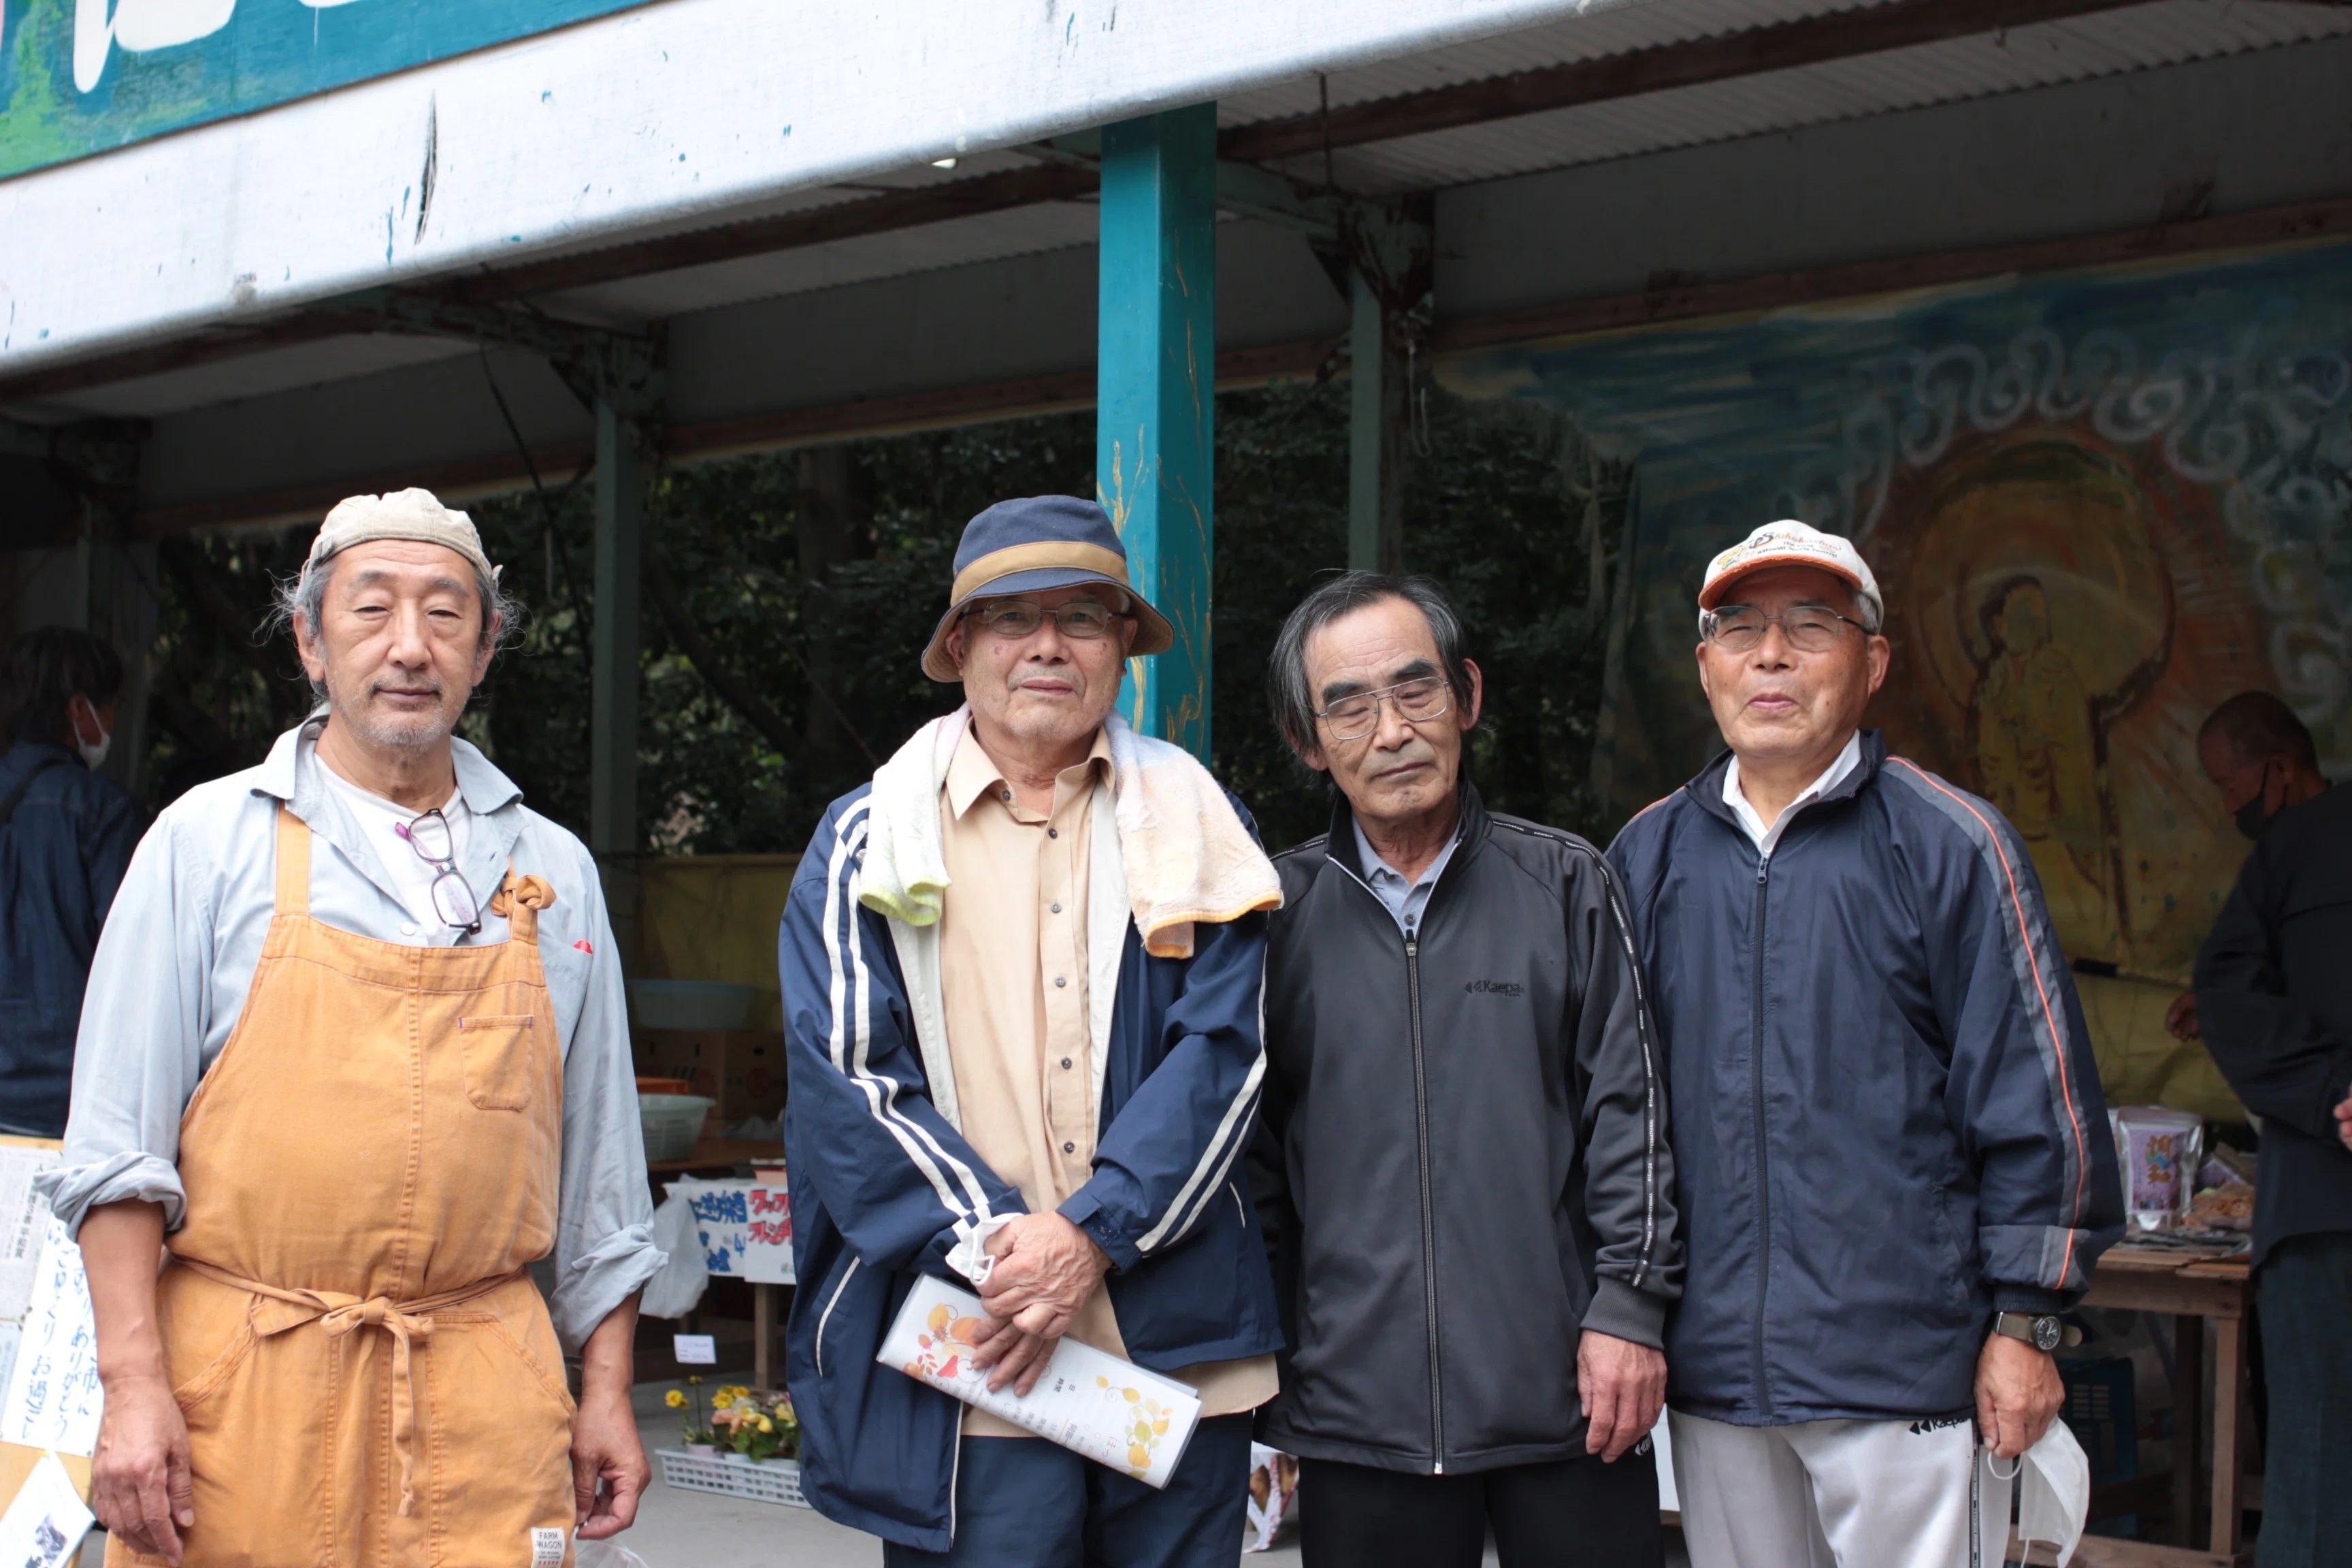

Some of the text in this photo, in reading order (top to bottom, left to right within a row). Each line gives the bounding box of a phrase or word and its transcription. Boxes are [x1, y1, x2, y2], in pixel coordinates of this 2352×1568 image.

[1483, 980, 1520, 996] Kaepa
[539, 1531, 559, 1539] FARM
[537, 1540, 562, 1549] WAGON
